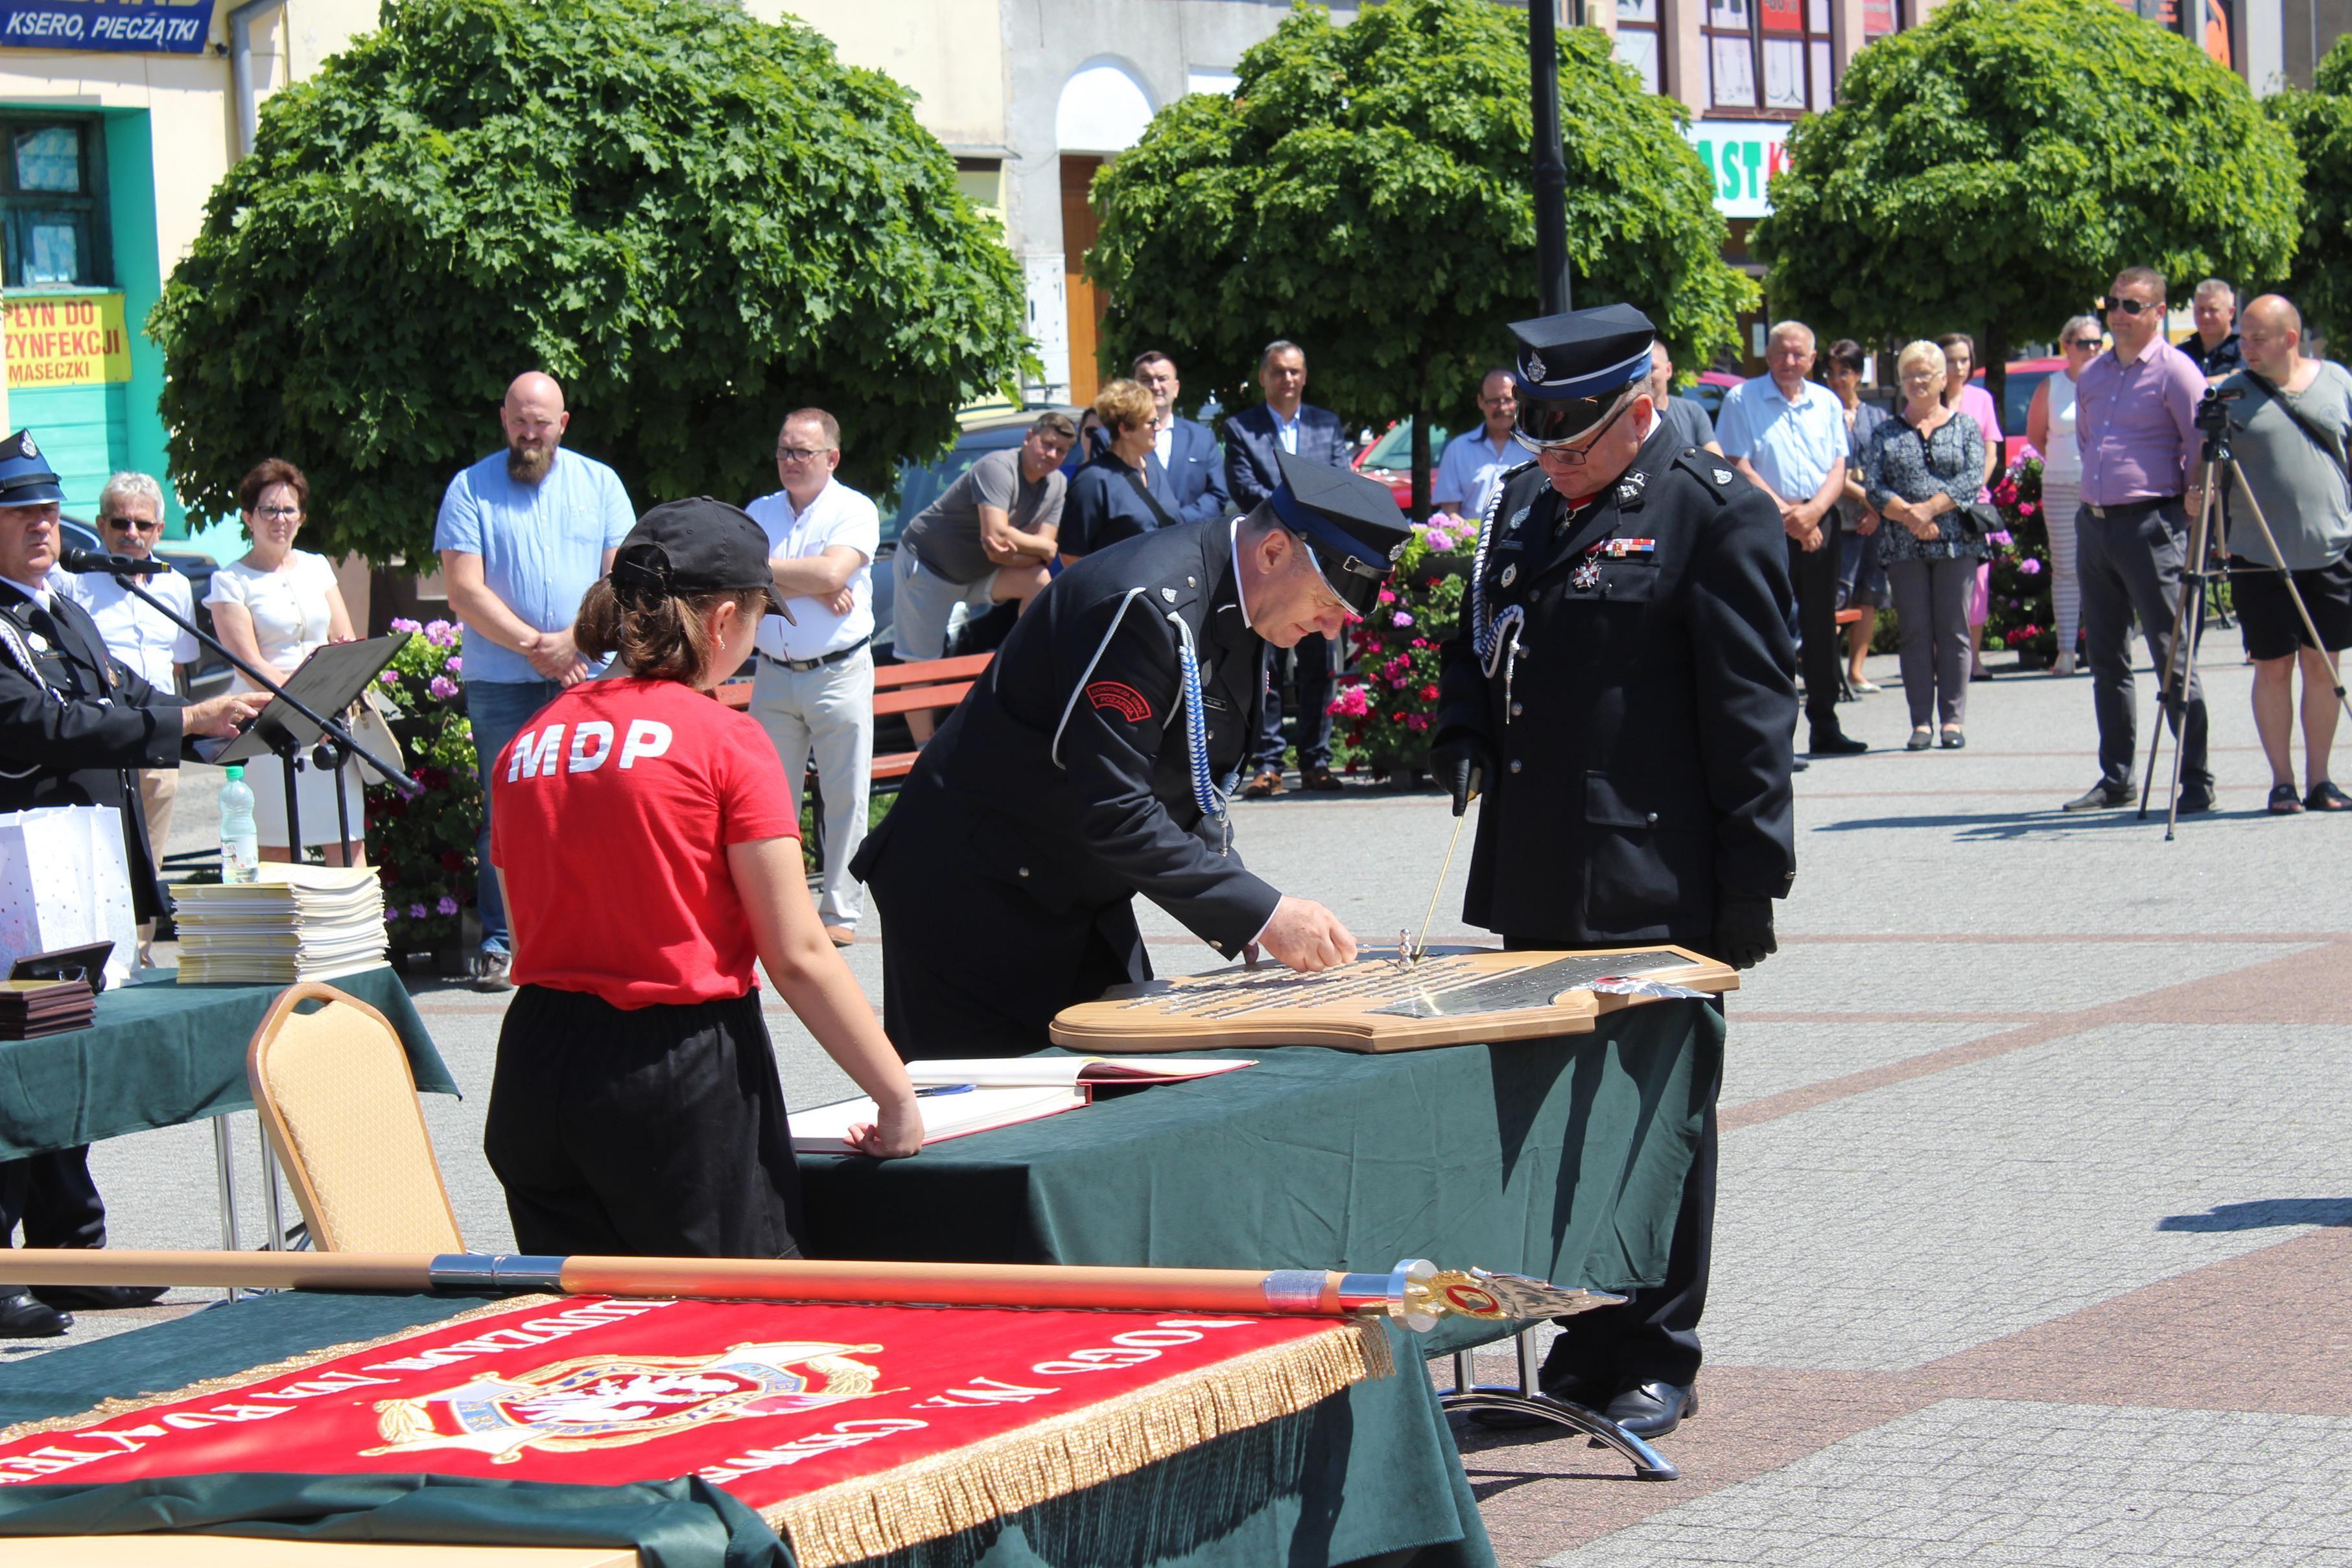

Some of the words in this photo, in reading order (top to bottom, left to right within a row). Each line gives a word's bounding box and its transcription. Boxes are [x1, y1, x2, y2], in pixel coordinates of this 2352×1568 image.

[6, 12, 85, 41] KSERO,
[91, 16, 200, 47] PIECZĄTKI
[64, 299, 95, 325] DO
[8, 361, 90, 383] MASECZKI
[508, 719, 673, 783] MDP
[908, 1376, 1061, 1409] NA
